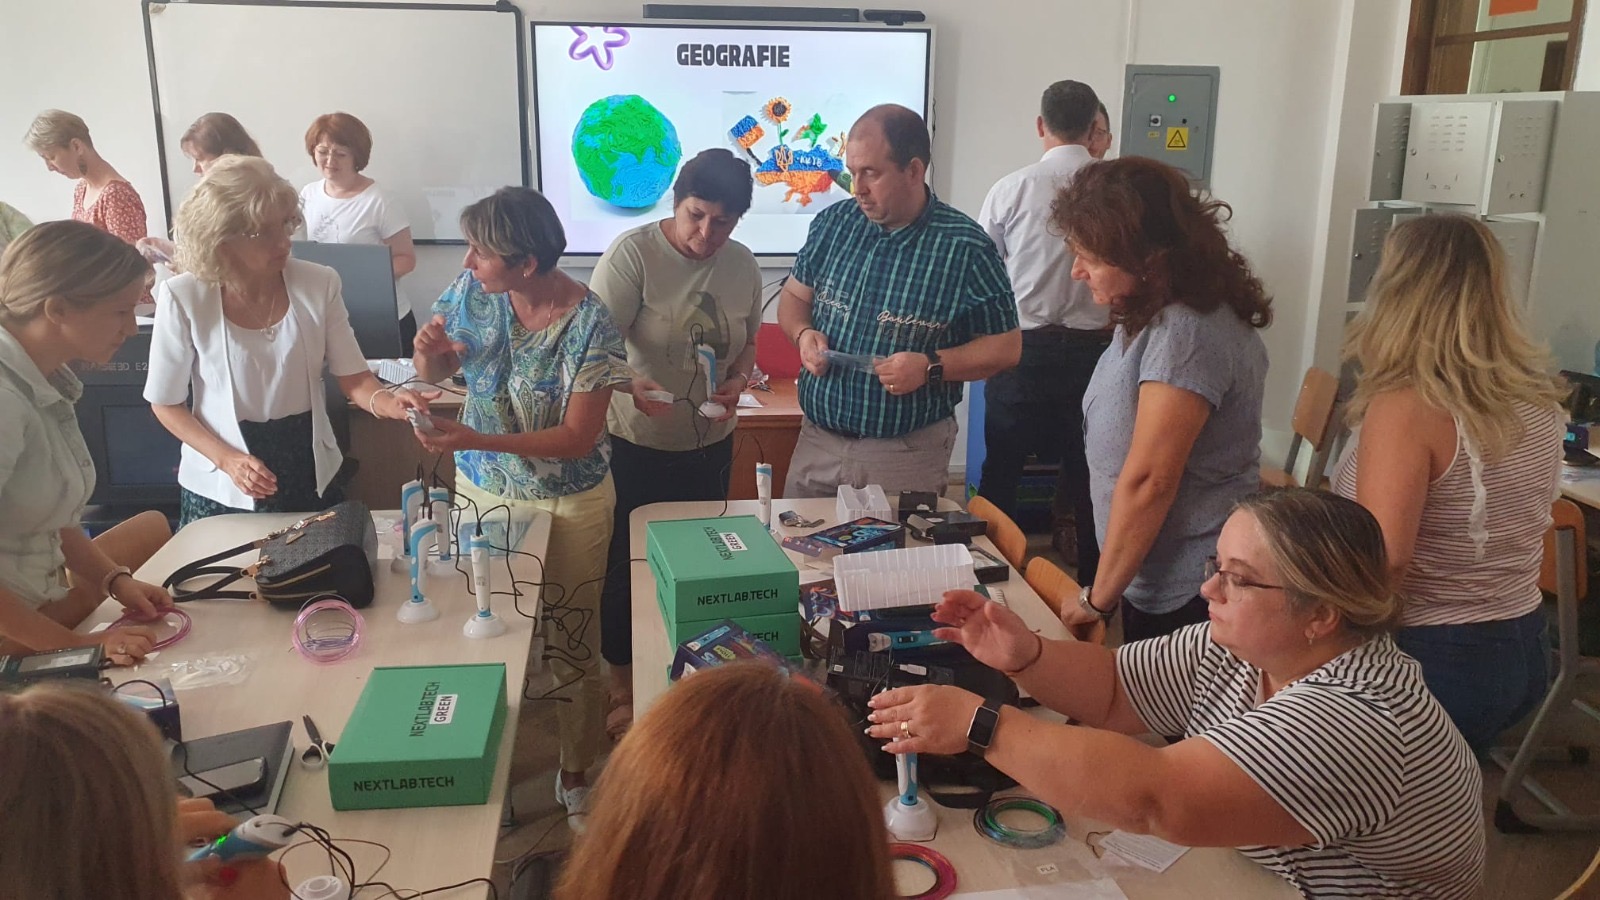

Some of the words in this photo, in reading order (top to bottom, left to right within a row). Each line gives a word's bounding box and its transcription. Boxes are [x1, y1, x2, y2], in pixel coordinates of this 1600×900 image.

[676, 43, 790, 67] GEOGRAFIE
[723, 533, 743, 550] GREEN
[697, 588, 778, 606] NEXTLAB.TECH
[433, 695, 453, 722] GREEN
[353, 776, 454, 792] NEXTLAB.TECH
